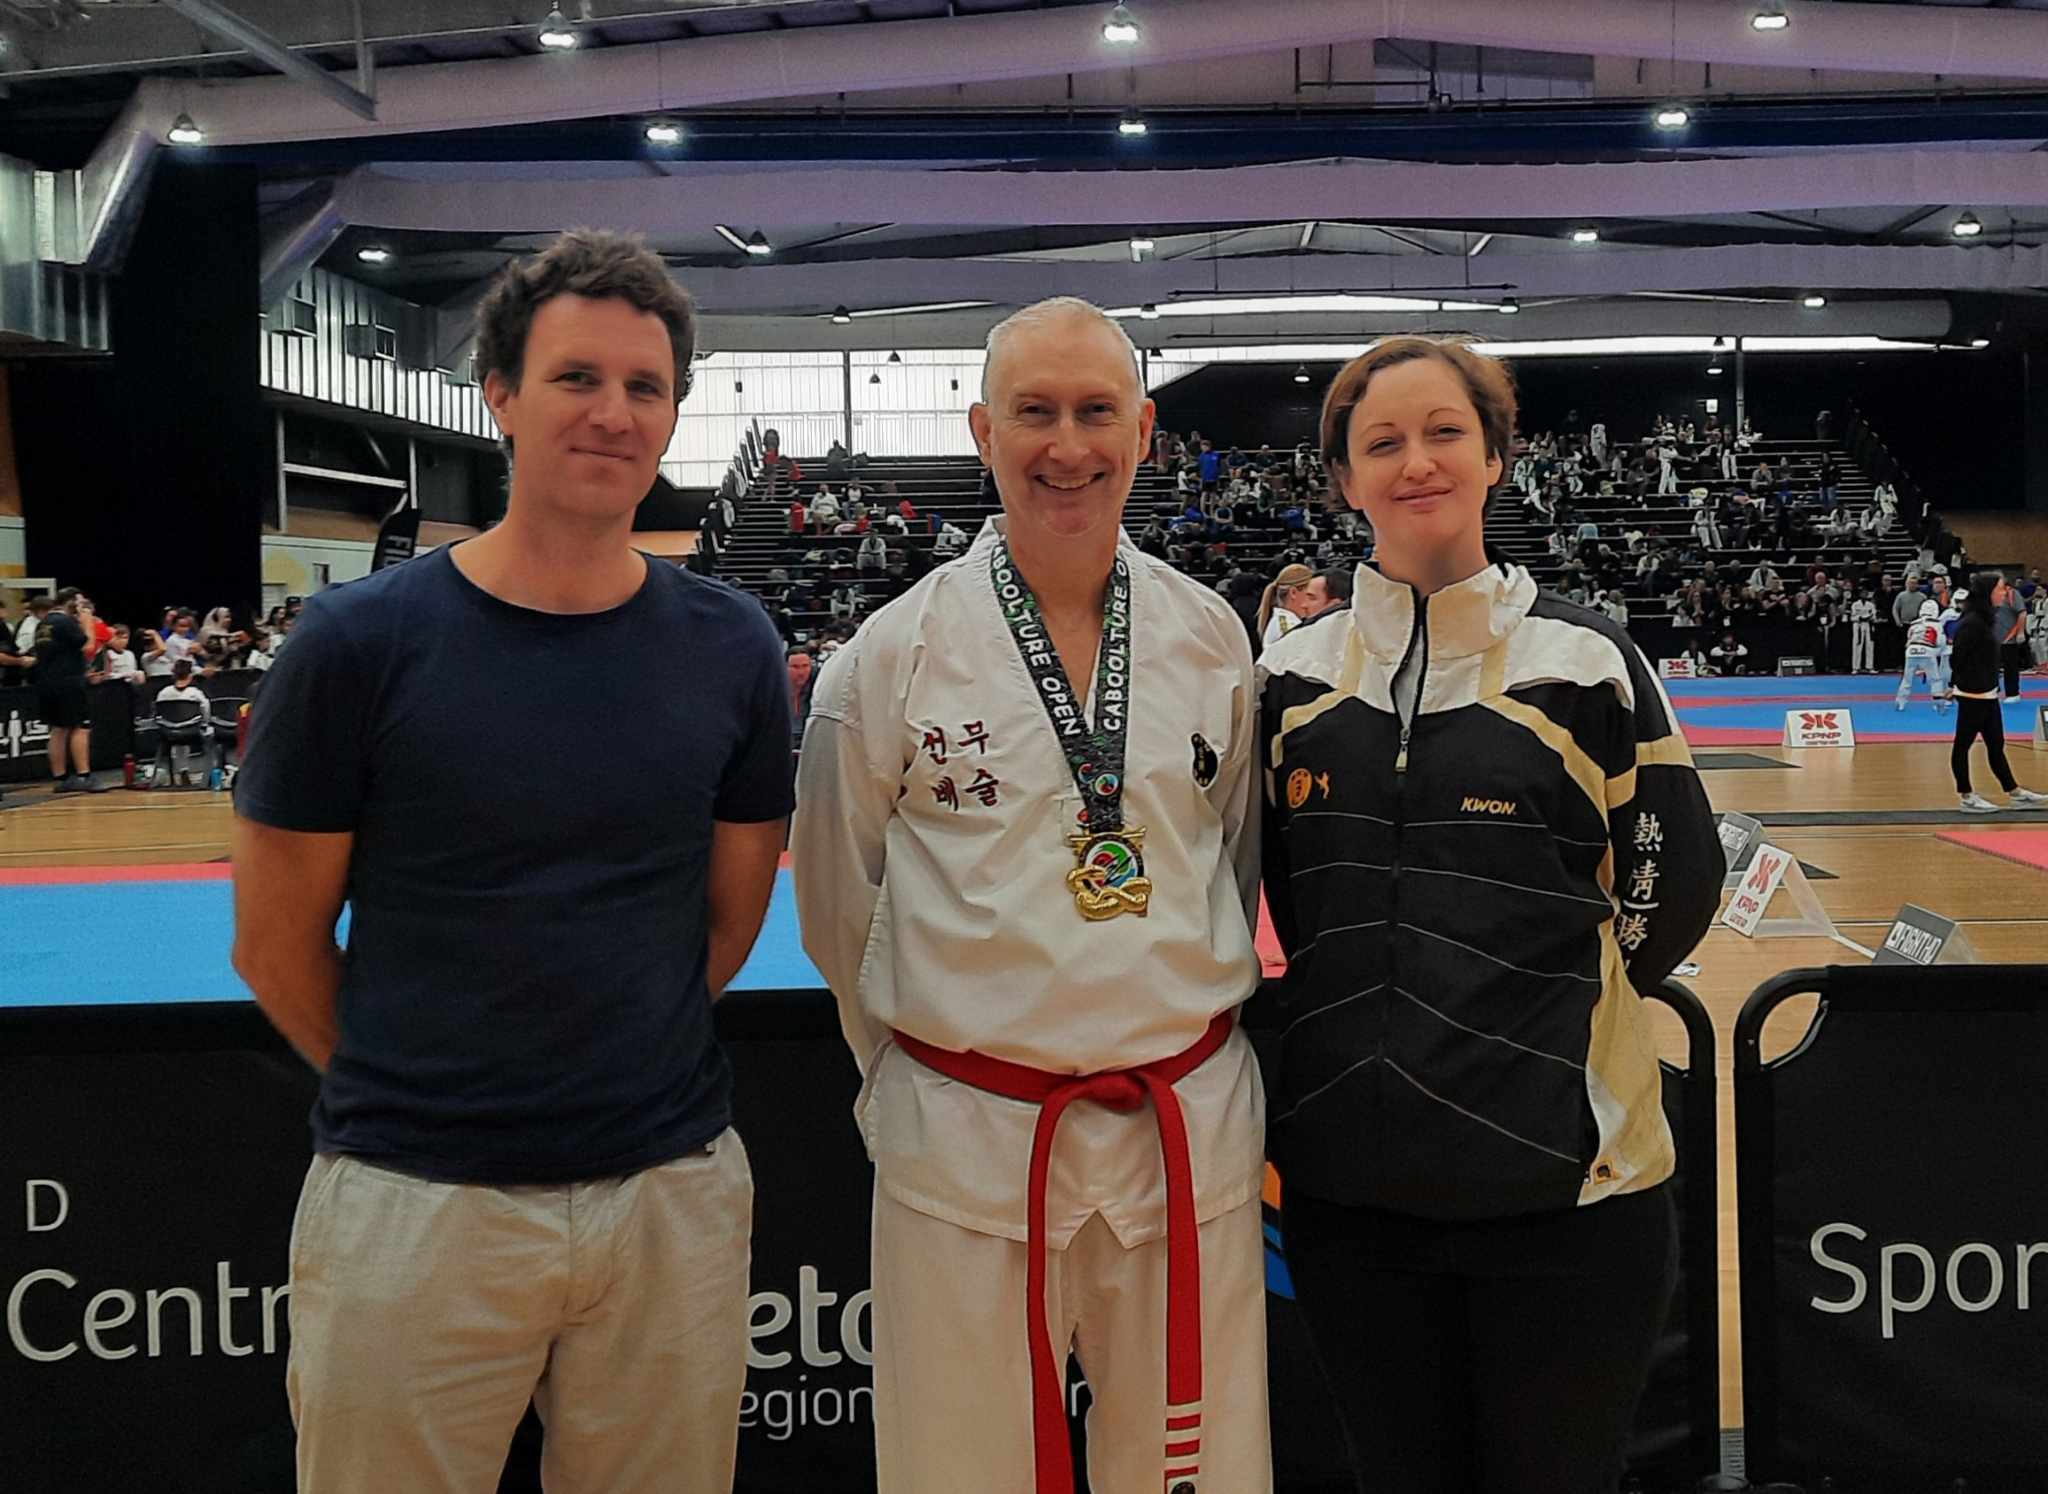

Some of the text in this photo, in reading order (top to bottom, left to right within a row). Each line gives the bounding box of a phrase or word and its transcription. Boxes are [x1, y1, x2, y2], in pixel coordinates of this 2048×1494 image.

[1103, 584, 1128, 731] CABOOLTURE
[1041, 676, 1081, 736] OPEN
[1460, 797, 1516, 815] KWON
